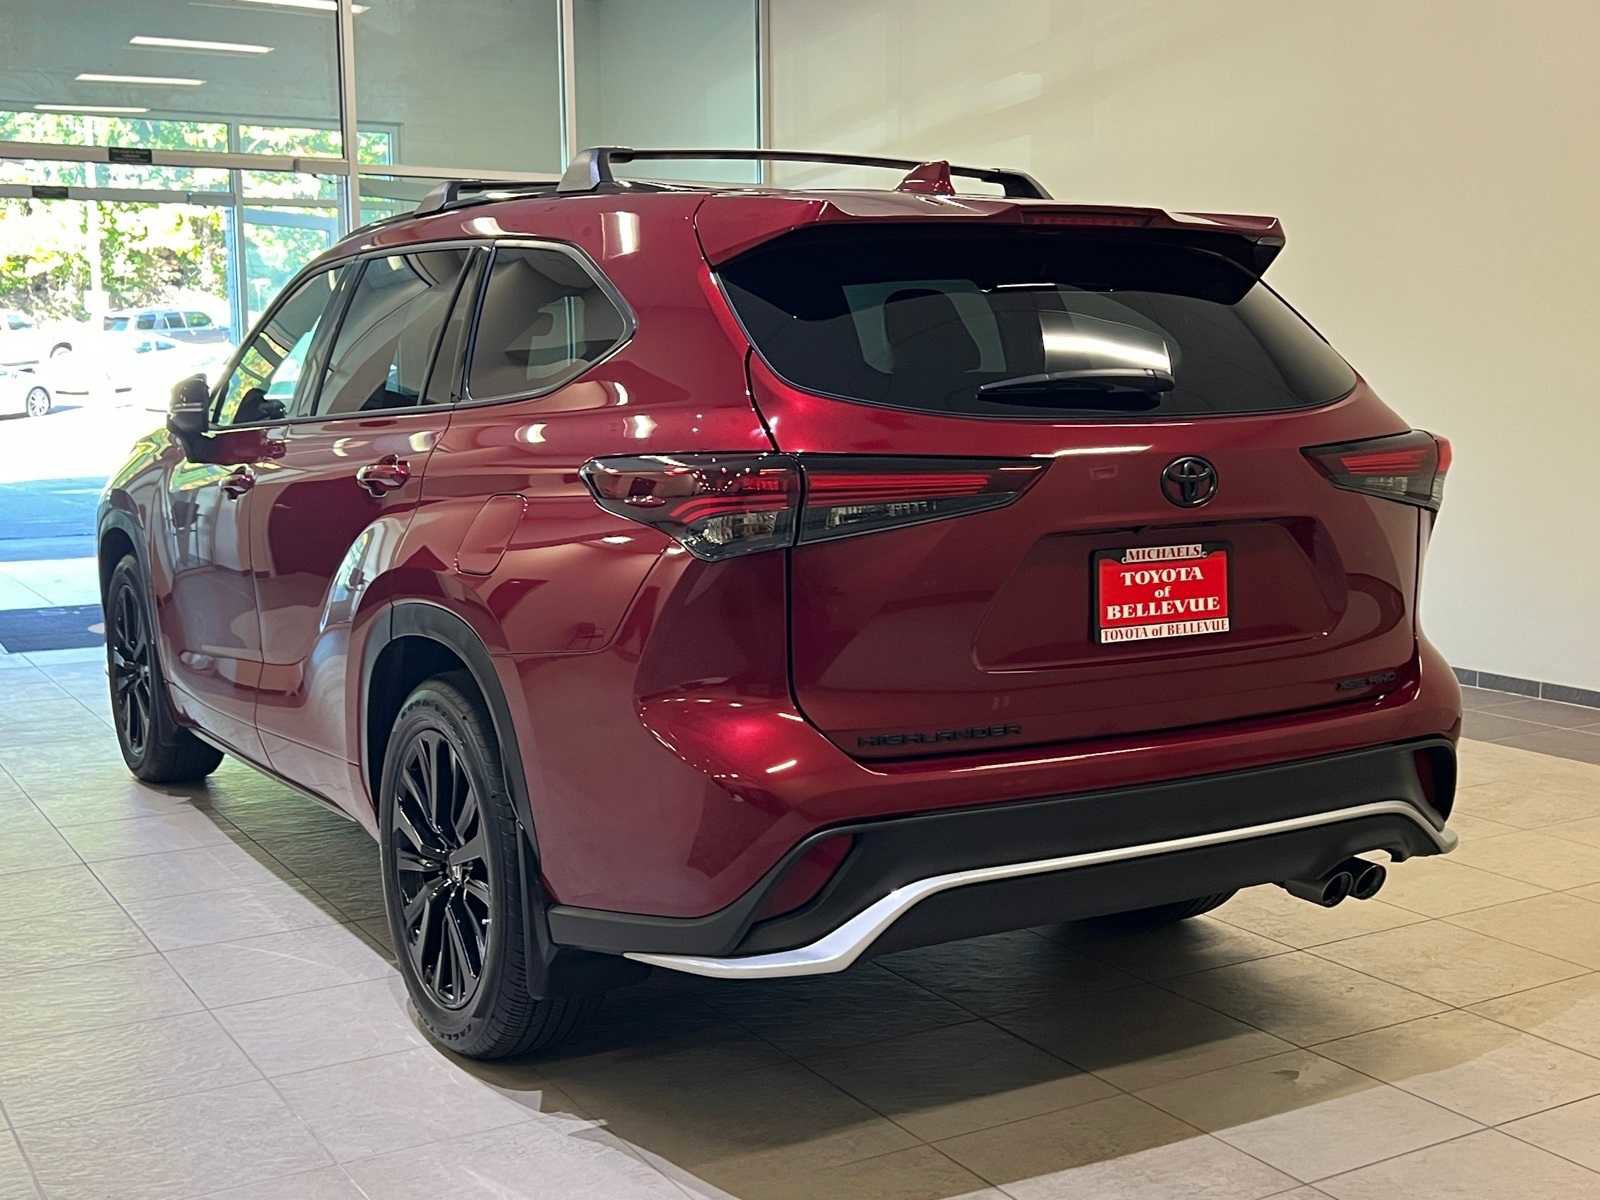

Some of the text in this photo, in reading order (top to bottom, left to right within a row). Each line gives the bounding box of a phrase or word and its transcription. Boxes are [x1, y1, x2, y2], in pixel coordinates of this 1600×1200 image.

[1128, 546, 1201, 561] MICHAELS
[1120, 567, 1204, 586] TOYOTA
[1154, 586, 1172, 598] of
[1106, 597, 1220, 620] BELLEVUE
[1103, 619, 1228, 641] TOYOTA of BELLEVUE
[857, 724, 1022, 747] HIGHLANDER
